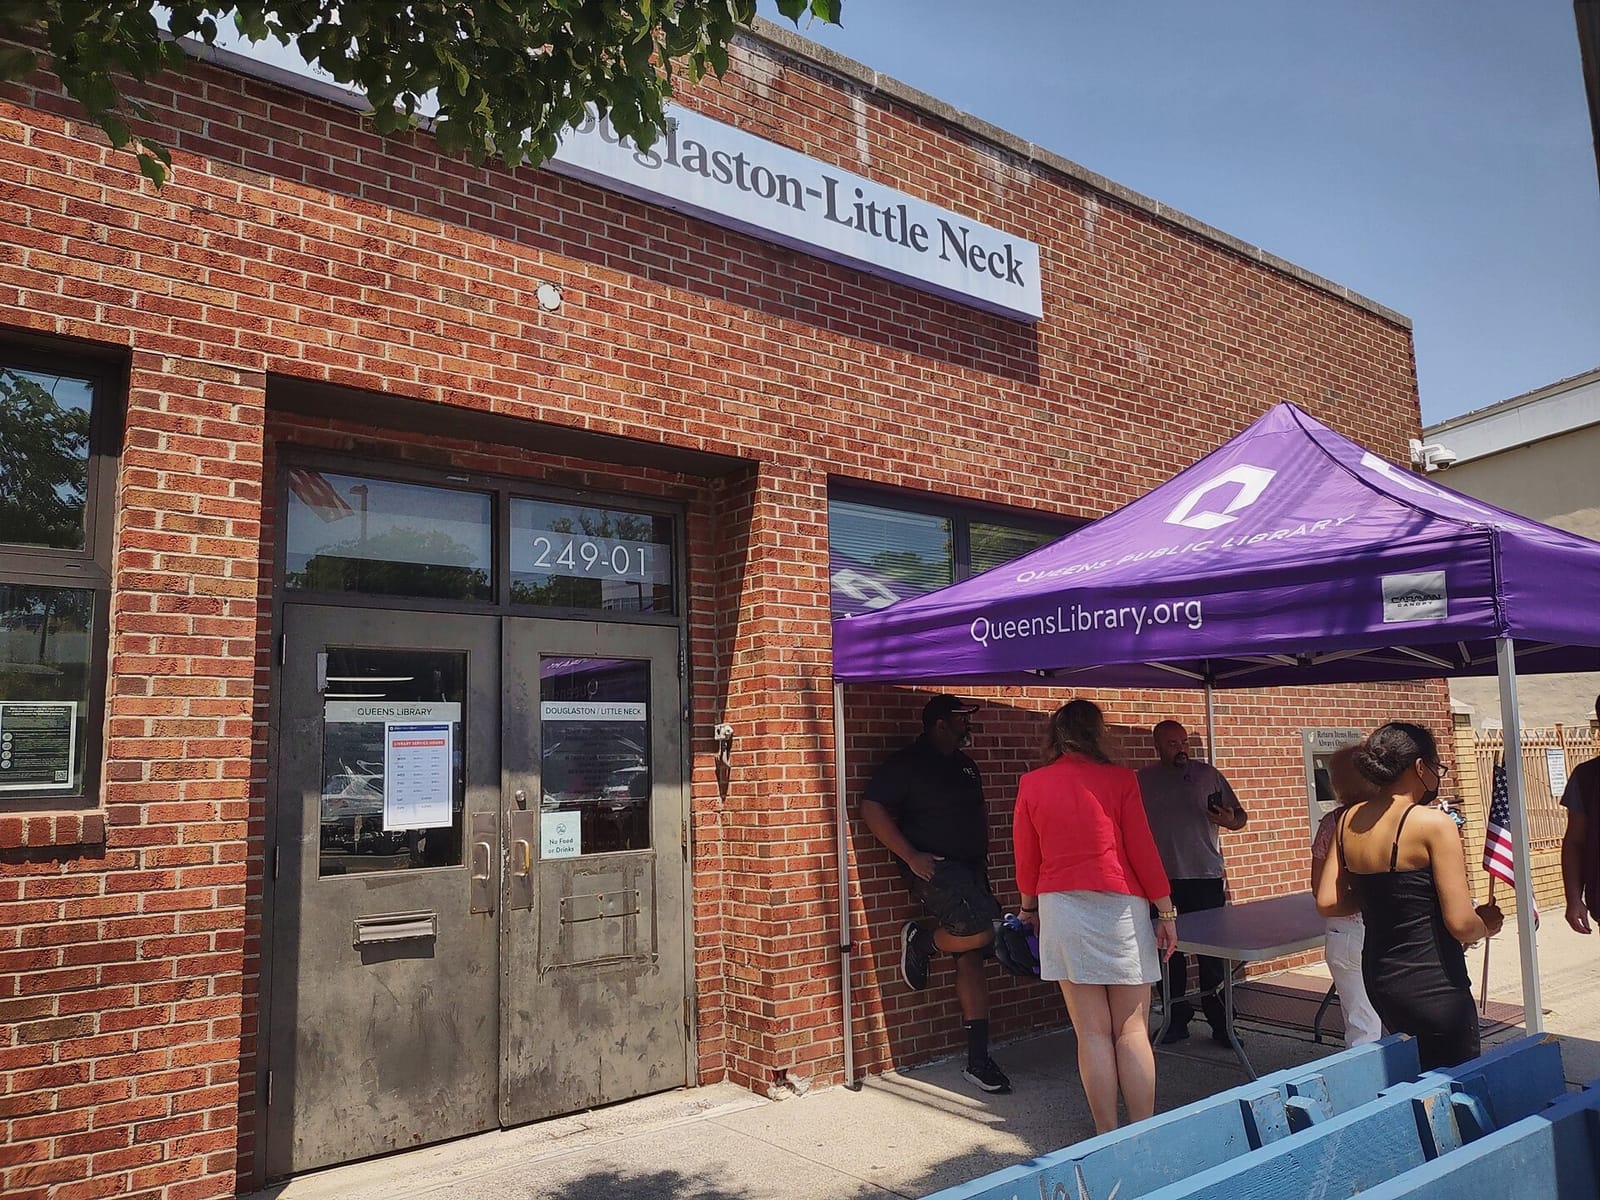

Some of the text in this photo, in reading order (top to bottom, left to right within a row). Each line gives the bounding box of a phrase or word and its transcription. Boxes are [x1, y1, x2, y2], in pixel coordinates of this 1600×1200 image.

[556, 101, 1025, 288] ouglaston-Little Neck
[533, 536, 645, 576] 249-01
[1016, 513, 1357, 583] QUEENS PUBLIC LIBRARY
[970, 599, 1203, 648] QueensLibrary.org
[357, 707, 433, 717] QUEENS LIBRARY
[545, 706, 596, 715] DOUGLASTON
[601, 707, 622, 715] LITTLE
